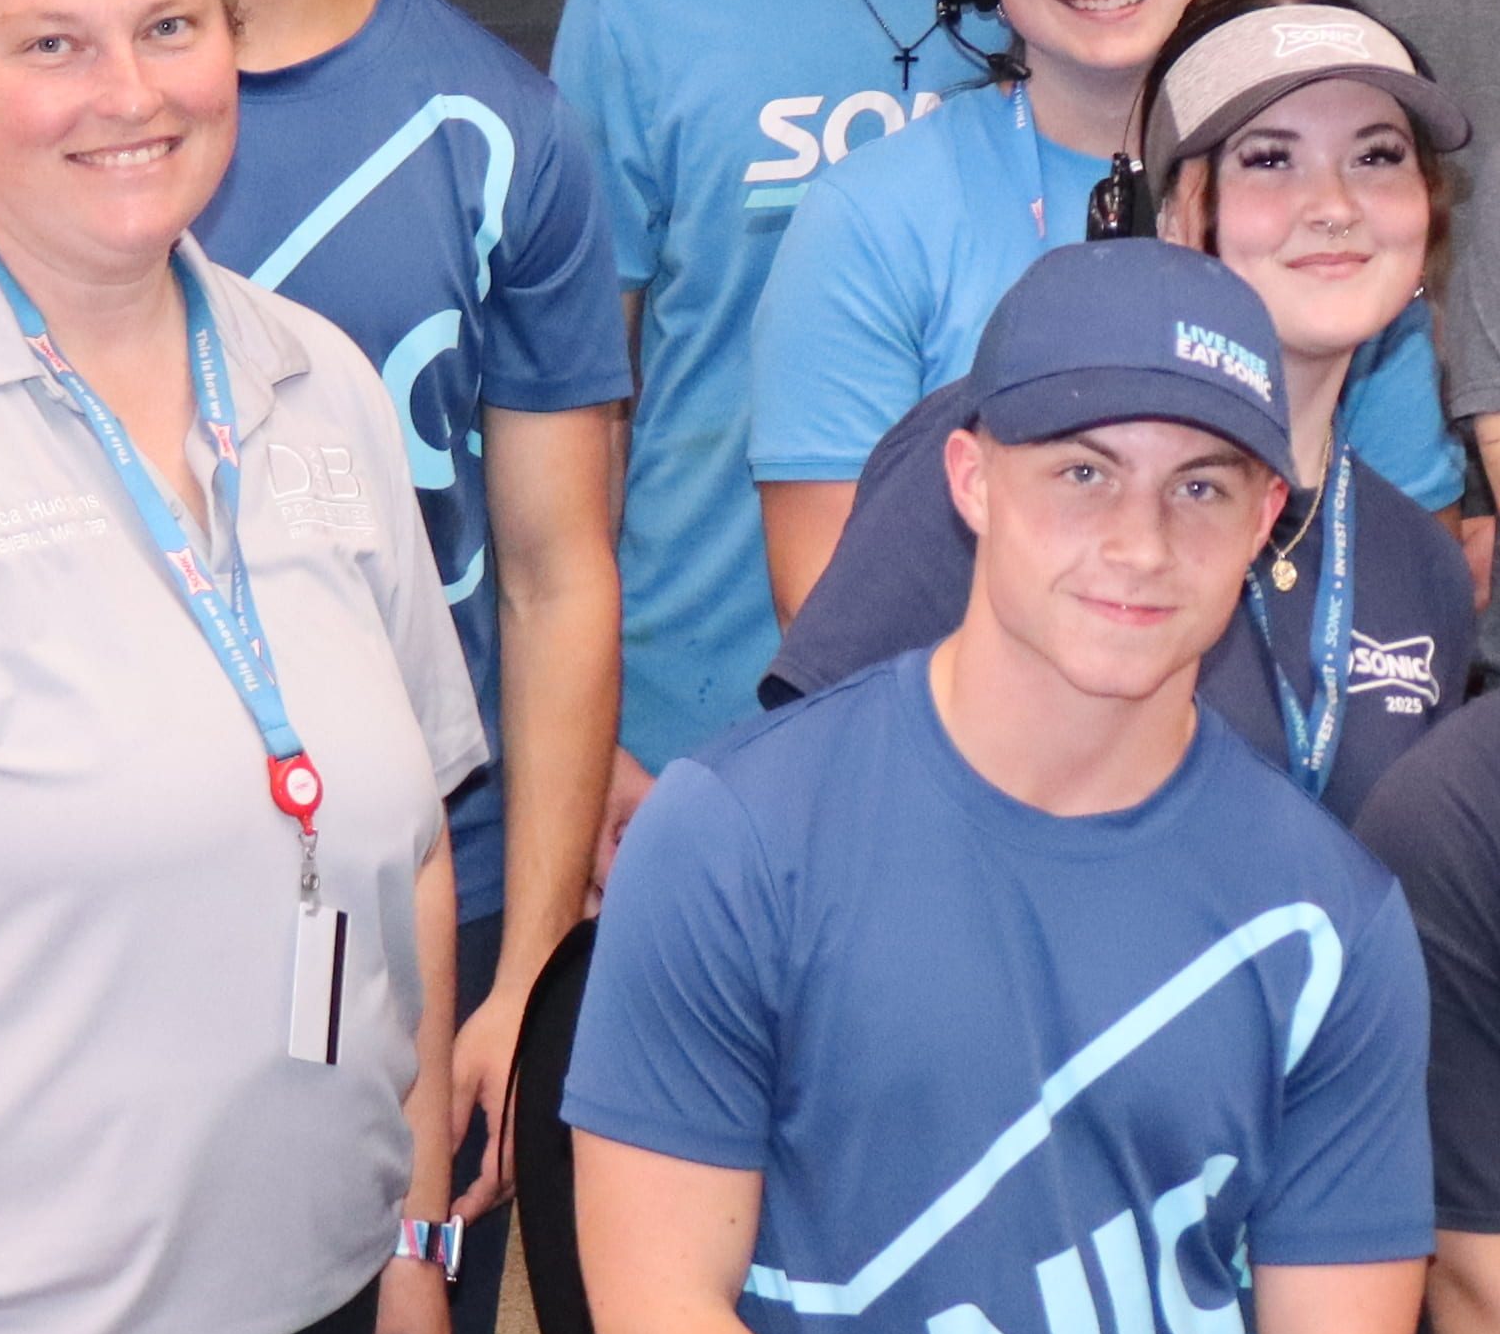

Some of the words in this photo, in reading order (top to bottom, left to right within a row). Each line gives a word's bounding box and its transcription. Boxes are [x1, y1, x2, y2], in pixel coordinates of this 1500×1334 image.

[1285, 30, 1359, 45] SONIC
[196, 329, 211, 357] This
[1176, 321, 1227, 353] LIVE
[1227, 340, 1268, 377] FREE
[1176, 337, 1220, 368] EAT
[1222, 354, 1272, 402] SONIC
[1325, 595, 1343, 648] SONIC
[1354, 647, 1430, 682] SONIC
[1385, 696, 1423, 714] 2025
